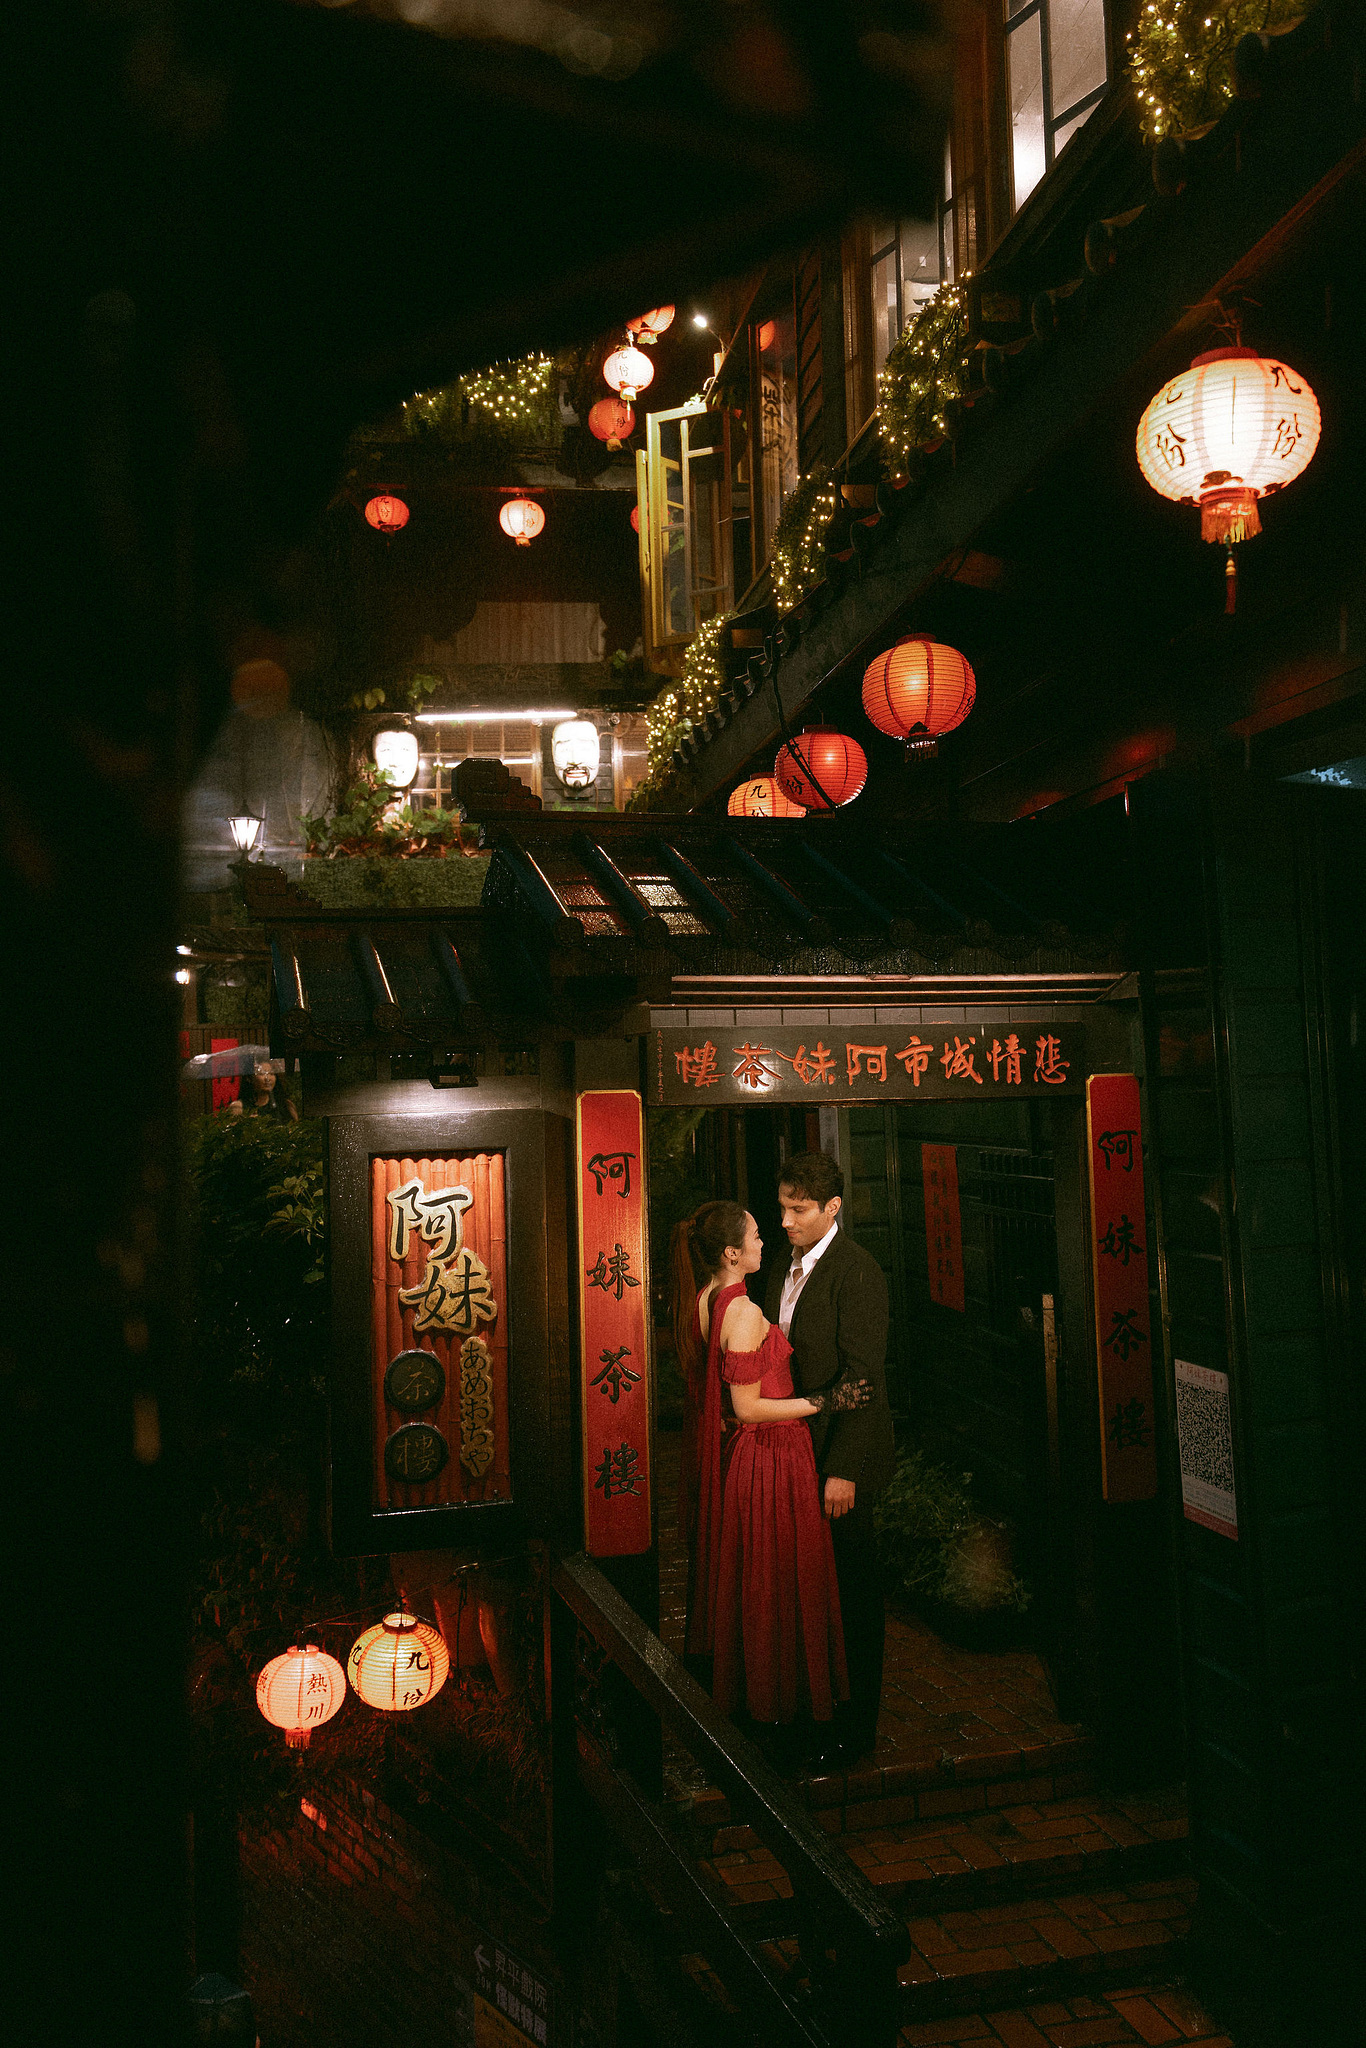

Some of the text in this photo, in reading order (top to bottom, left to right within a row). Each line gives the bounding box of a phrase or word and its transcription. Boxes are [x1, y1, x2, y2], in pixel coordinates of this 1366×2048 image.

[1156, 383, 1186, 470] 九份
[1270, 366, 1302, 459] 九份
[394, 1186, 491, 1329] 阿妹
[1099, 1130, 1150, 1450] 阿妹茶樓
[587, 1151, 646, 1499] 阿妹茶樓
[305, 1673, 328, 1721] 熱川
[403, 1651, 430, 1705] 九份
